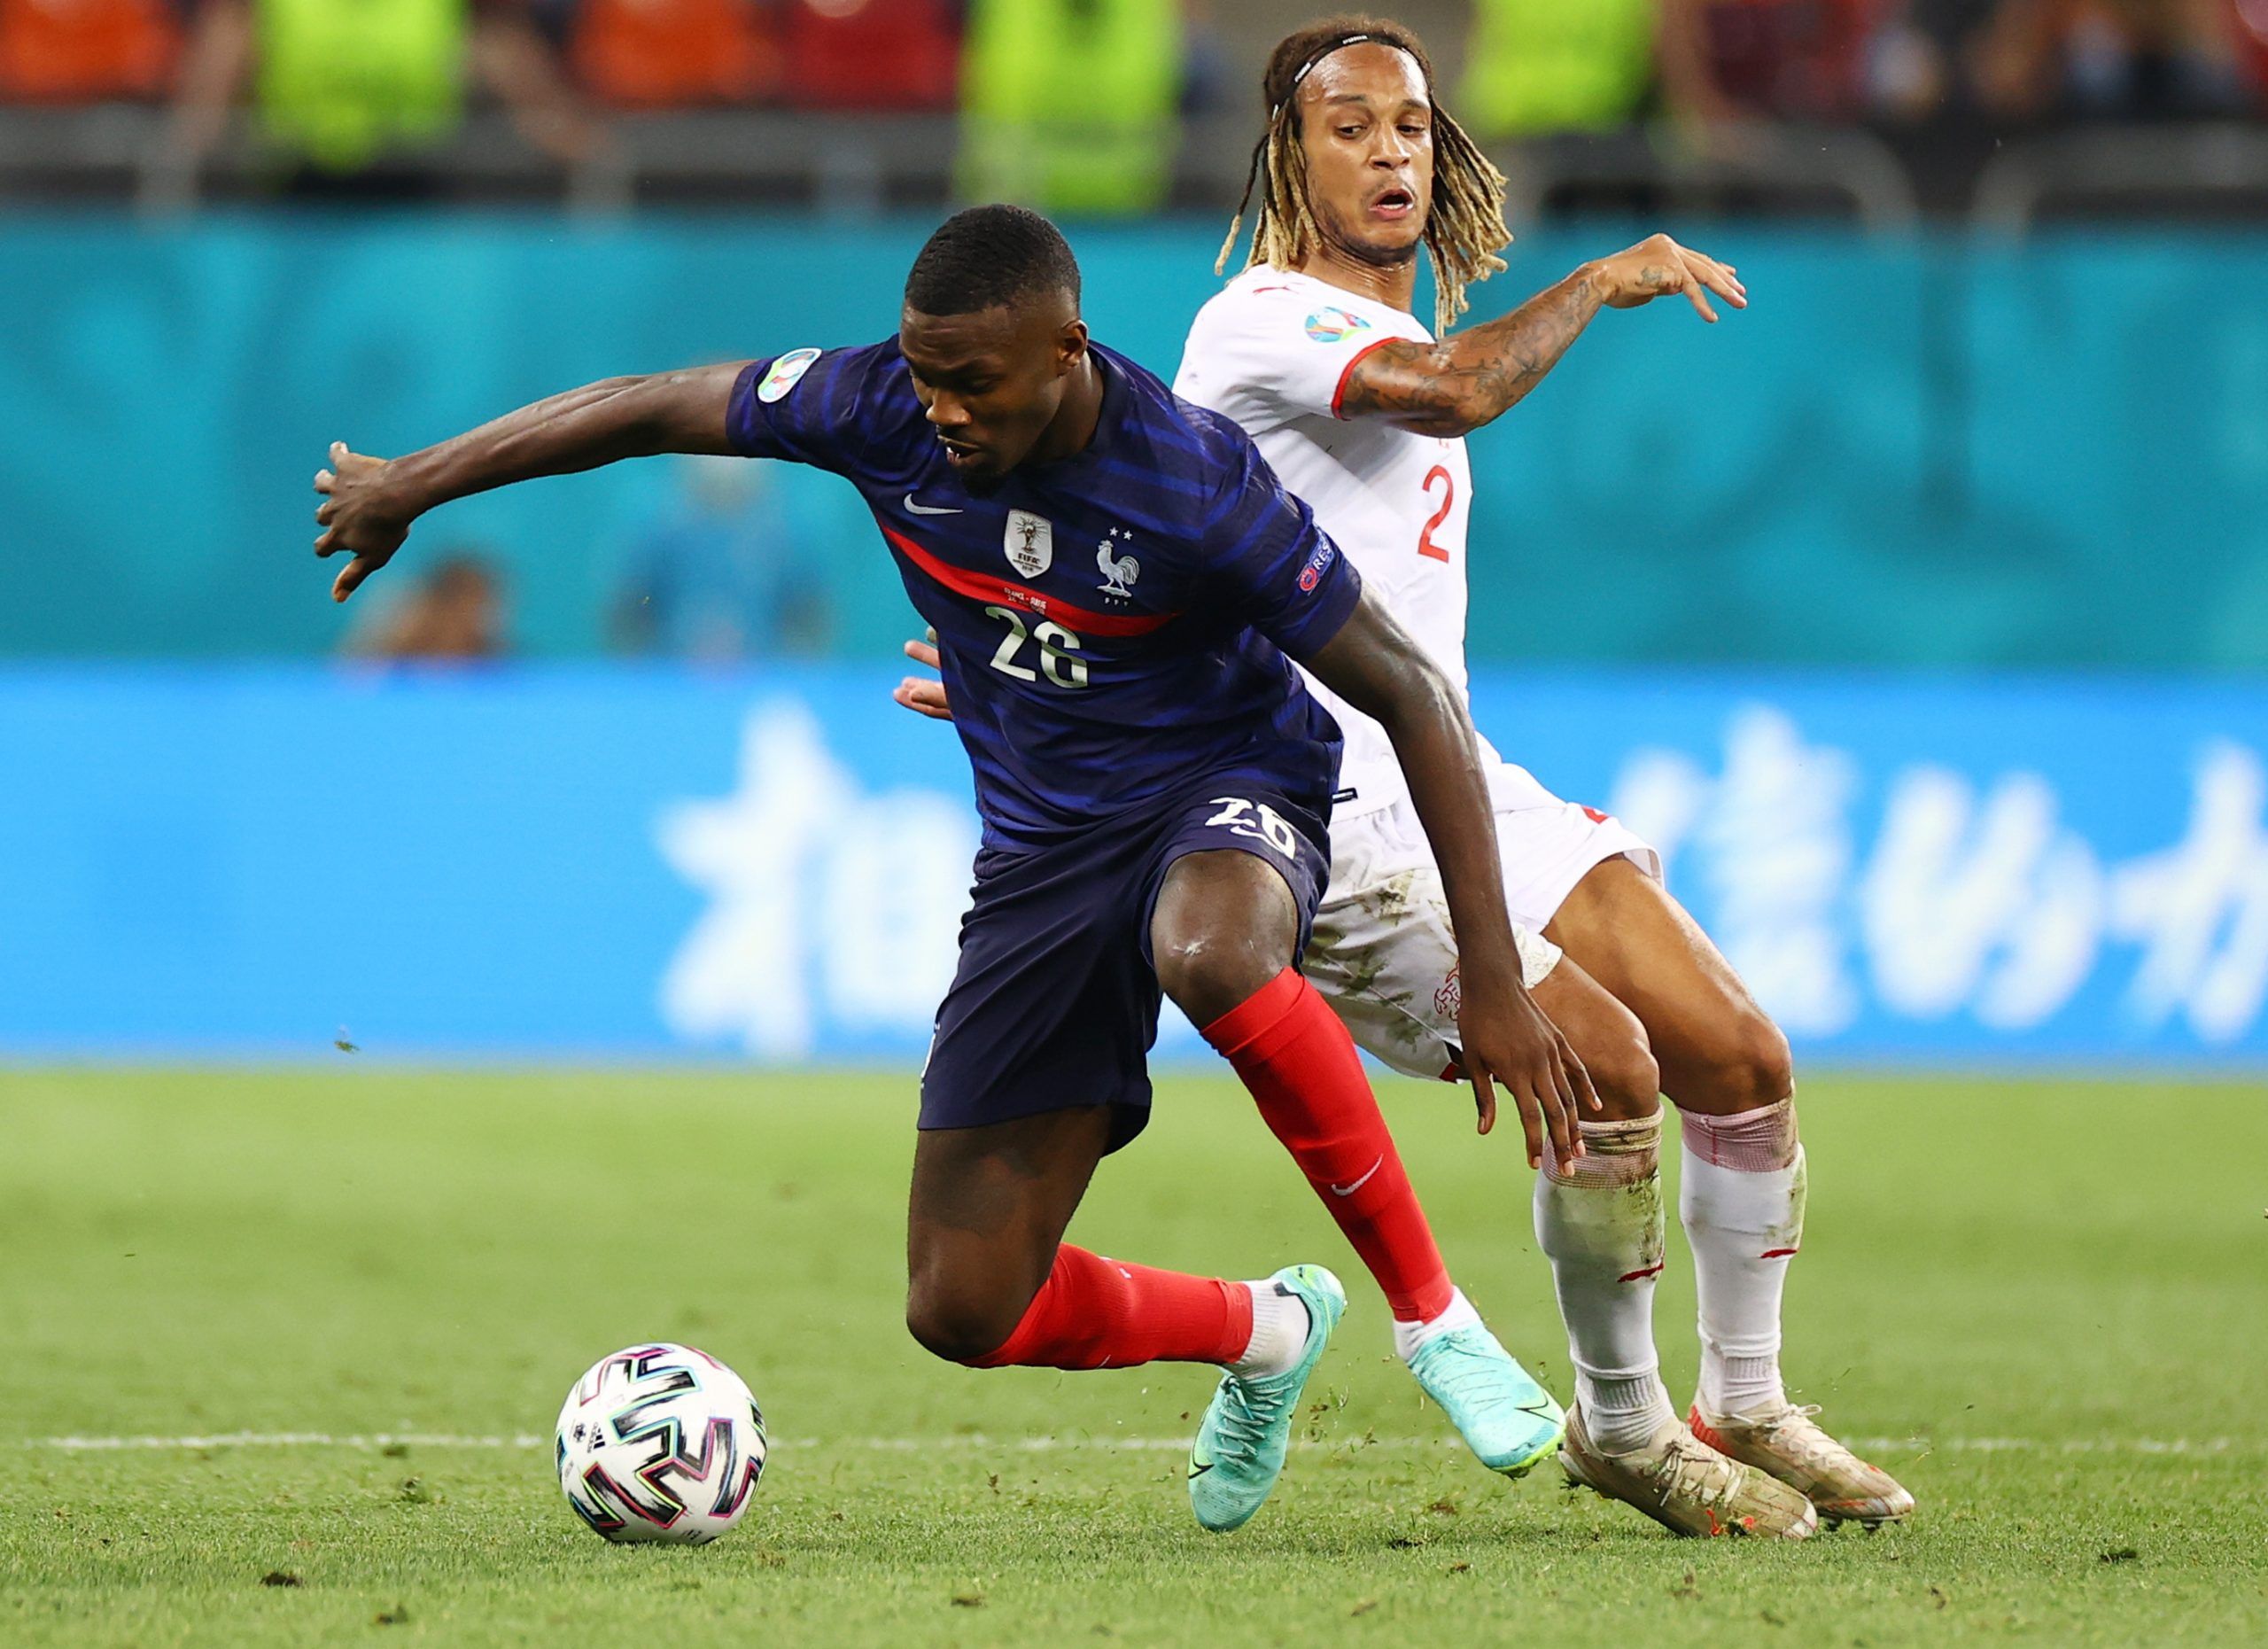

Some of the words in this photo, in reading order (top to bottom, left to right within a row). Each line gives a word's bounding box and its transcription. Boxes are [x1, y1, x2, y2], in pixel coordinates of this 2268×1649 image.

[1418, 464, 1454, 564] 2
[984, 606, 1088, 688] 26
[1205, 797, 1295, 860] 26
